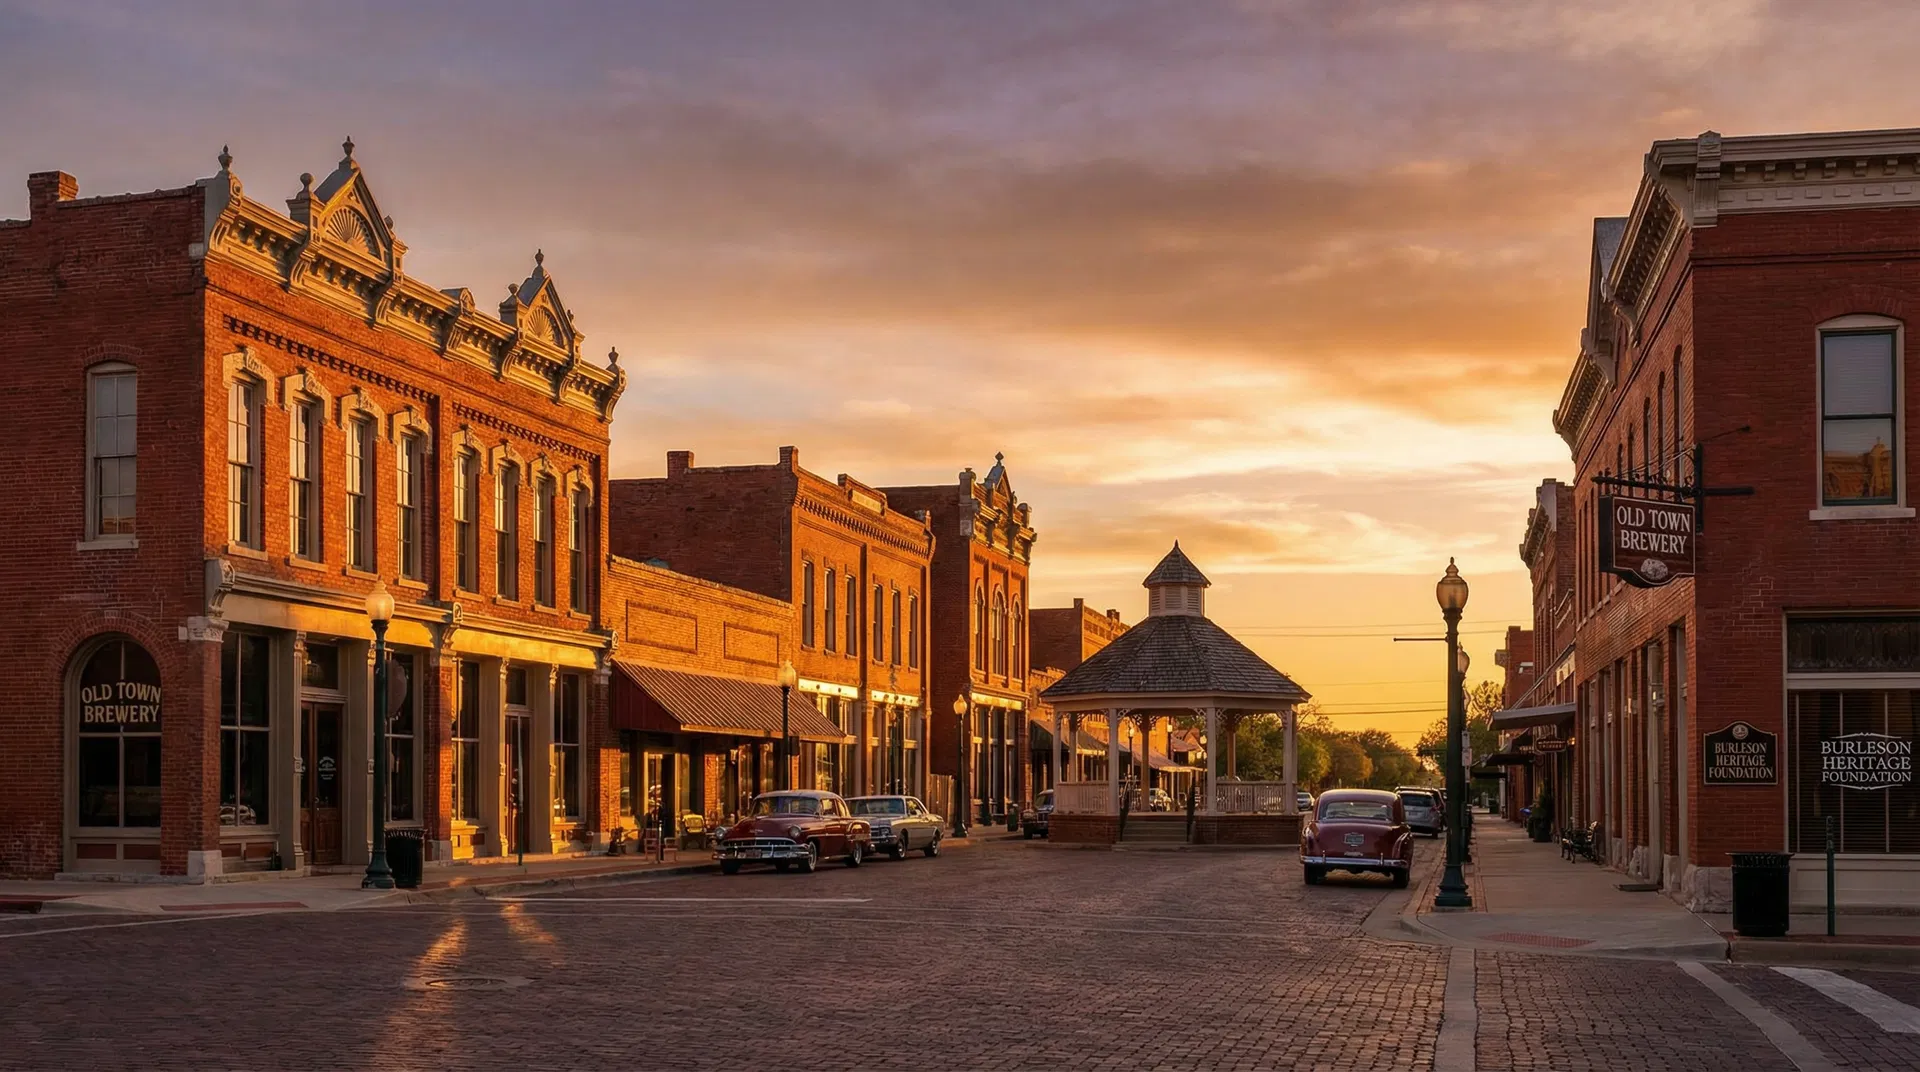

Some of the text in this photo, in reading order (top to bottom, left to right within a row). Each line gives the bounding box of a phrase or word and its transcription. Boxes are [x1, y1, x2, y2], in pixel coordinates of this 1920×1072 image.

[1616, 505, 1691, 533] OLD TOWN
[1620, 529, 1687, 555] BREWERY
[81, 681, 161, 704] OLD TOWN
[84, 705, 160, 724] BREWERY
[1714, 742, 1767, 754] BURLESON
[1820, 741, 1912, 754] BURLESON
[1716, 754, 1766, 767] HERITAGE
[1822, 756, 1912, 770] HERITAGE
[1708, 767, 1774, 779] FOUNDATION
[1821, 771, 1912, 783] FOUNDATION
